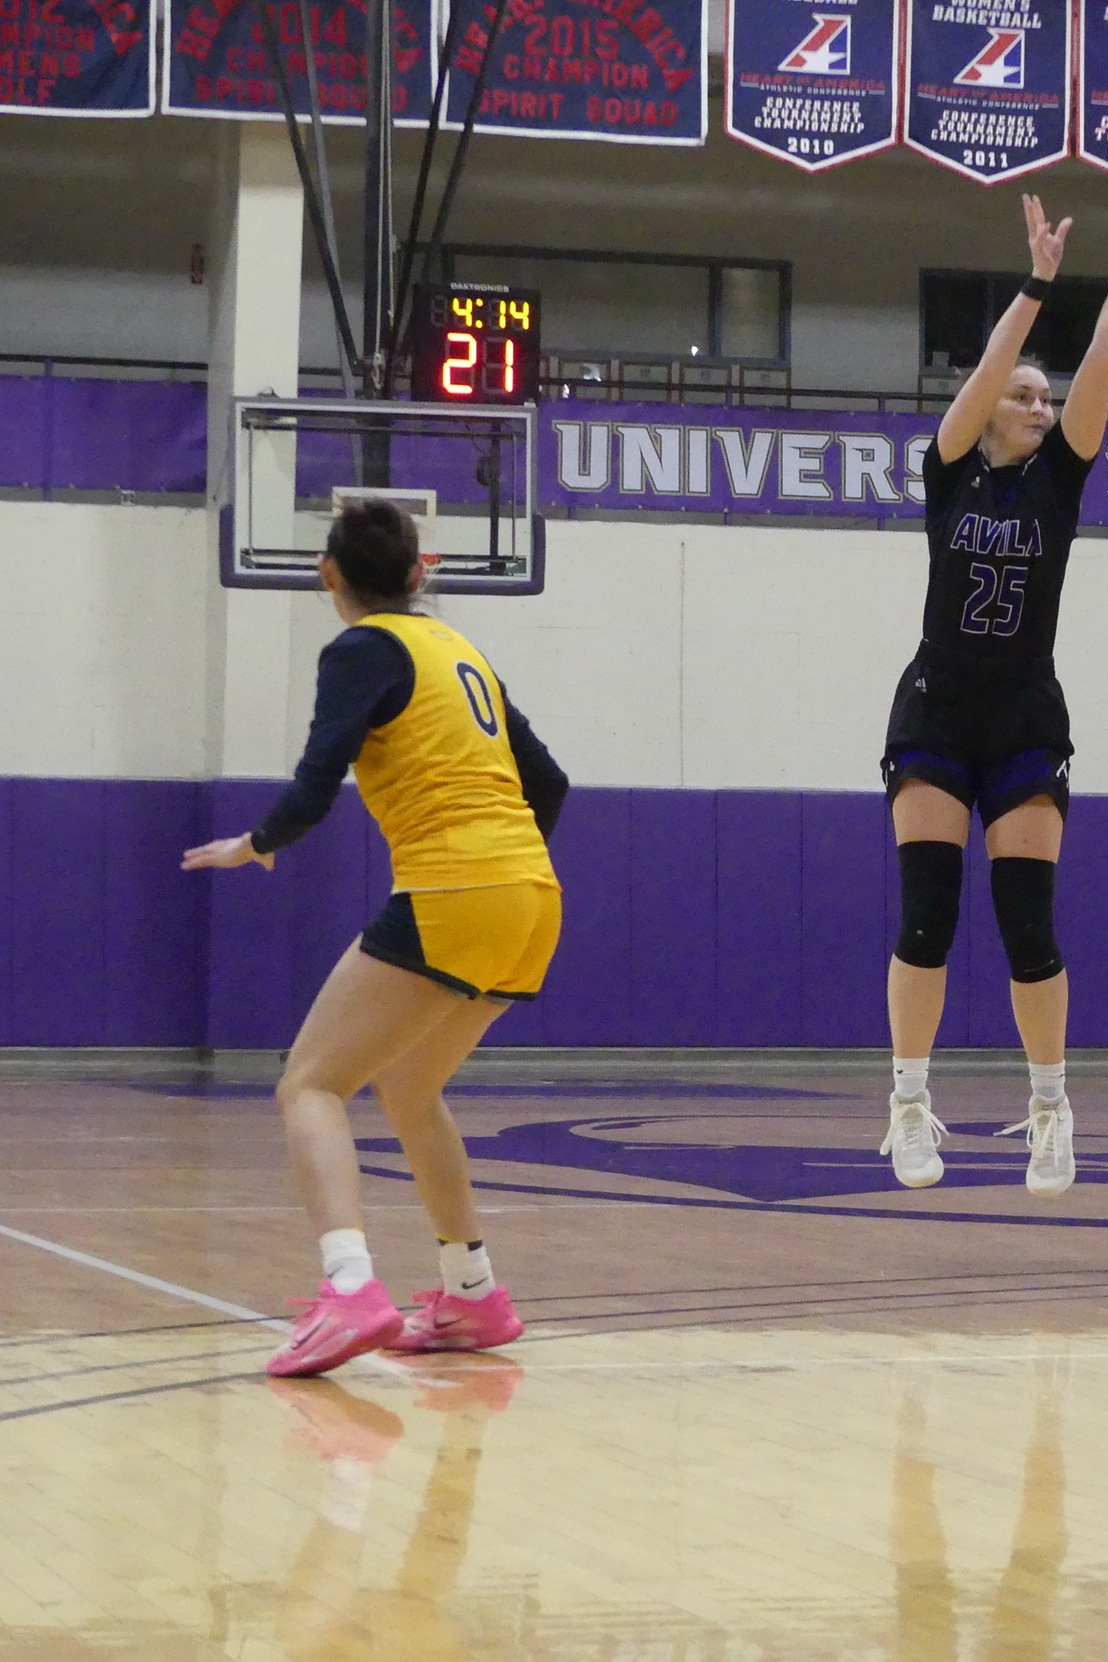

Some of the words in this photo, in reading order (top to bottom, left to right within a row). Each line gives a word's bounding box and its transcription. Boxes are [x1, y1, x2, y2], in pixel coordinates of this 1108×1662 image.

[932, 4, 1042, 29] BASKETBALL
[0, 21, 95, 53] MPION
[523, 14, 620, 60] 2015
[0, 50, 82, 79] MENS
[225, 47, 370, 79] CHMPIO
[503, 54, 650, 89] CHAMPION
[0, 77, 57, 105] OLF
[194, 75, 292, 104] SPIRI
[766, 96, 860, 112] CONFERENCE
[586, 96, 679, 127] SQUAD
[754, 117, 865, 134] CHAMPIONSHIP
[761, 107, 862, 123] TOURNAMENT
[943, 109, 1034, 127] CONFERENCE
[931, 130, 1039, 148] CHAMPIONSHIP
[939, 120, 1035, 138] TOURNAMENT
[787, 136, 834, 155] 2010
[963, 150, 1008, 168] 2011
[453, 297, 530, 330] 4:14
[443, 332, 514, 394] 21
[950, 513, 1042, 557] AVILA
[960, 562, 1028, 636] 25
[456, 661, 498, 739] 0
